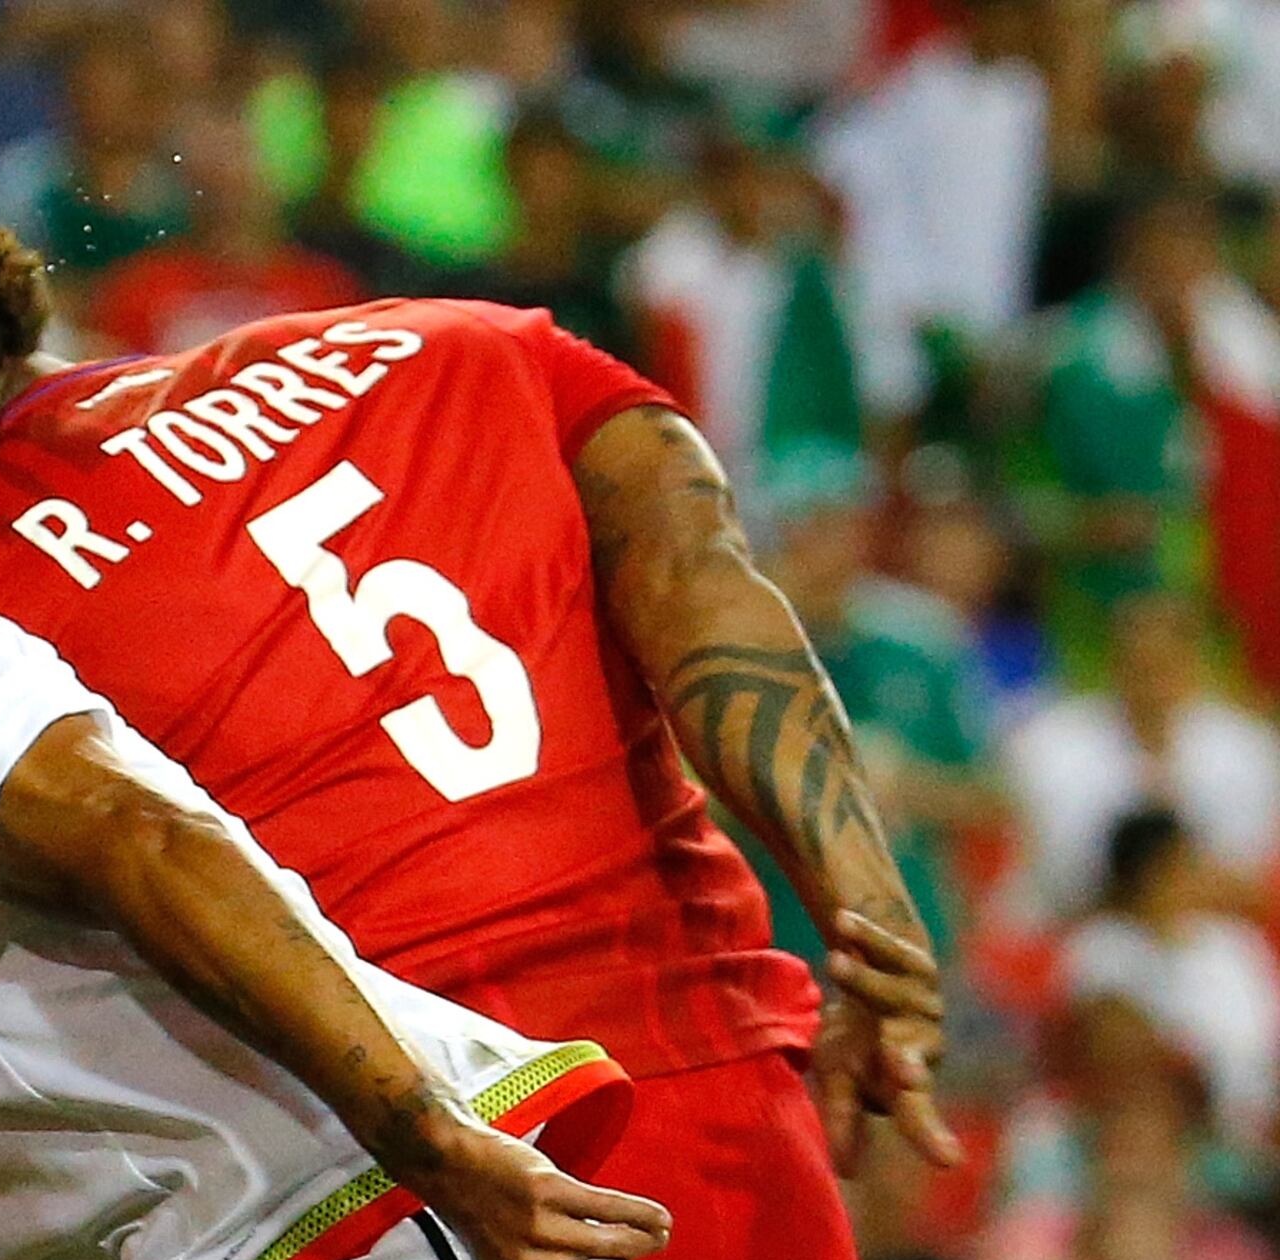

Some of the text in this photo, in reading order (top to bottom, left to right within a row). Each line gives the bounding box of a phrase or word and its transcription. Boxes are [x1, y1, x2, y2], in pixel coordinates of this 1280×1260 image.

[11, 320, 425, 591] R. TORRES
[246, 459, 542, 803] 5
